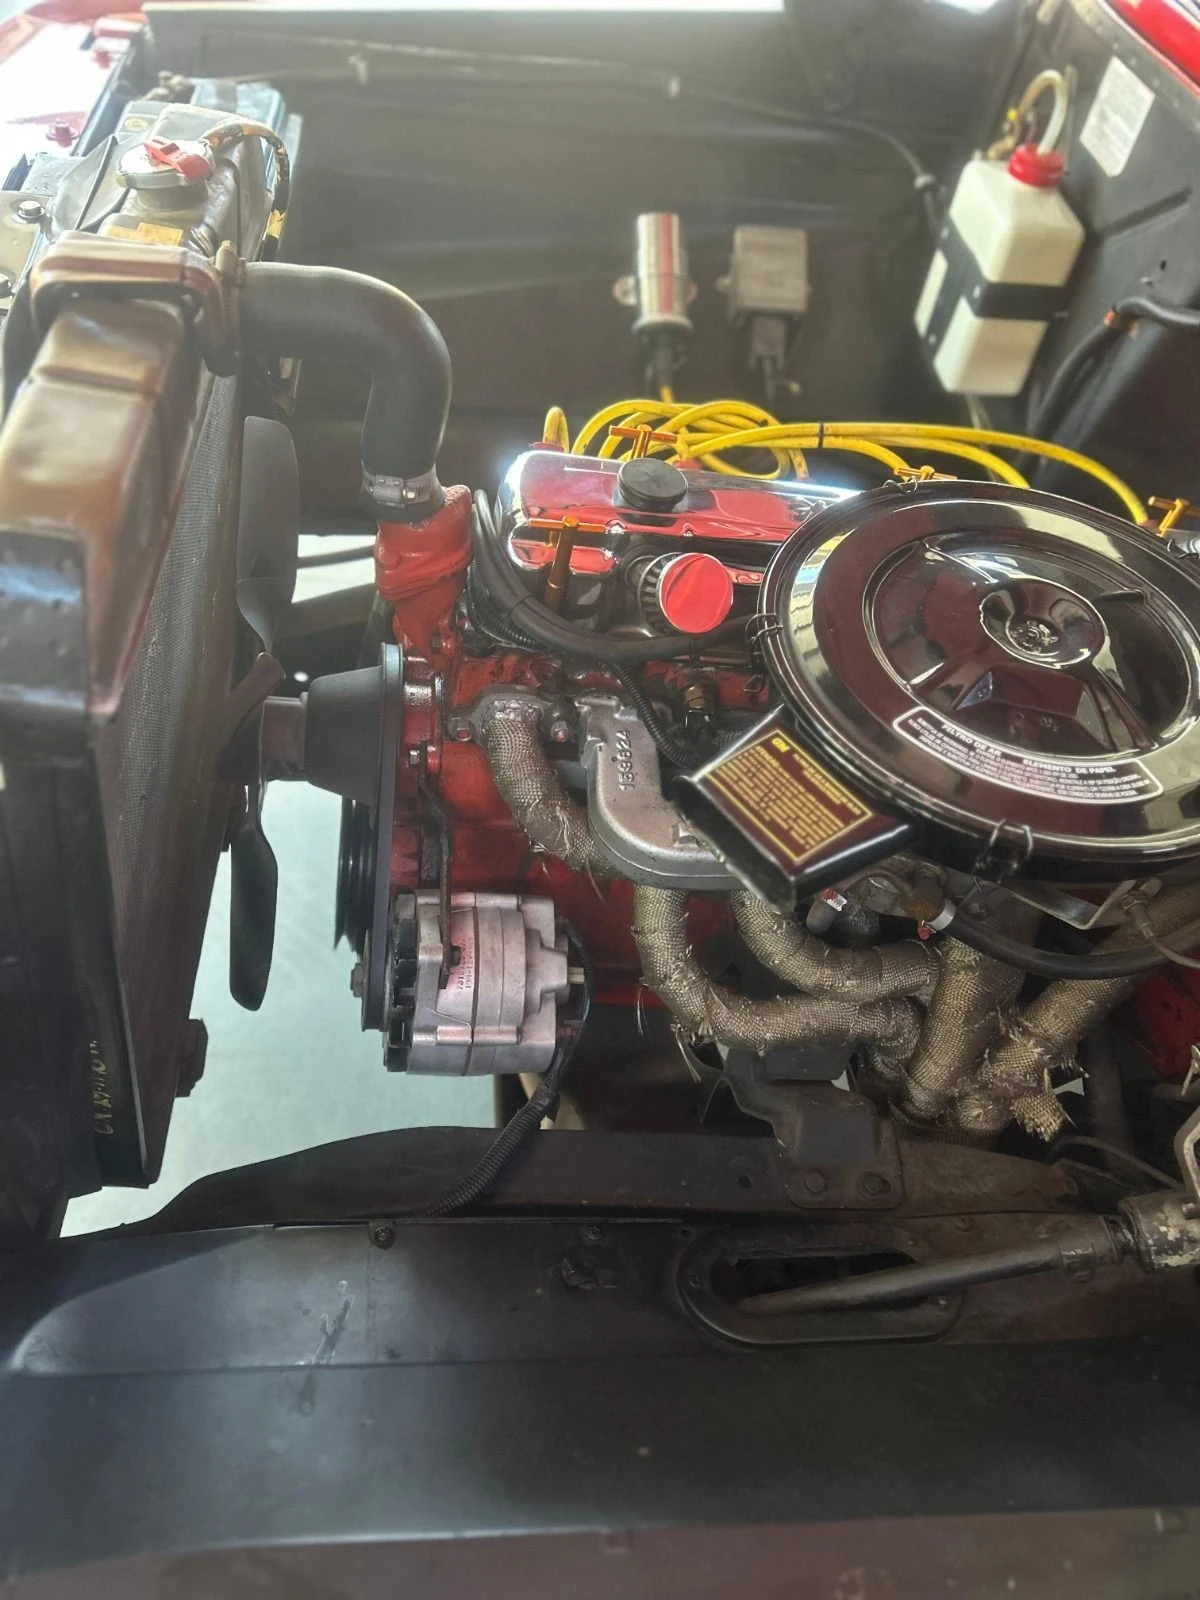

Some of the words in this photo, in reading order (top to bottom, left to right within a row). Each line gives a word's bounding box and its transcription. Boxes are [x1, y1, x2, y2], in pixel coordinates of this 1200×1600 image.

[941, 724, 974, 744] FILTRO
[973, 741, 987, 751] DE
[987, 747, 1002, 757] AR
[1022, 758, 1072, 773] ELEMENTO
[1089, 766, 1117, 774] PAPEL
